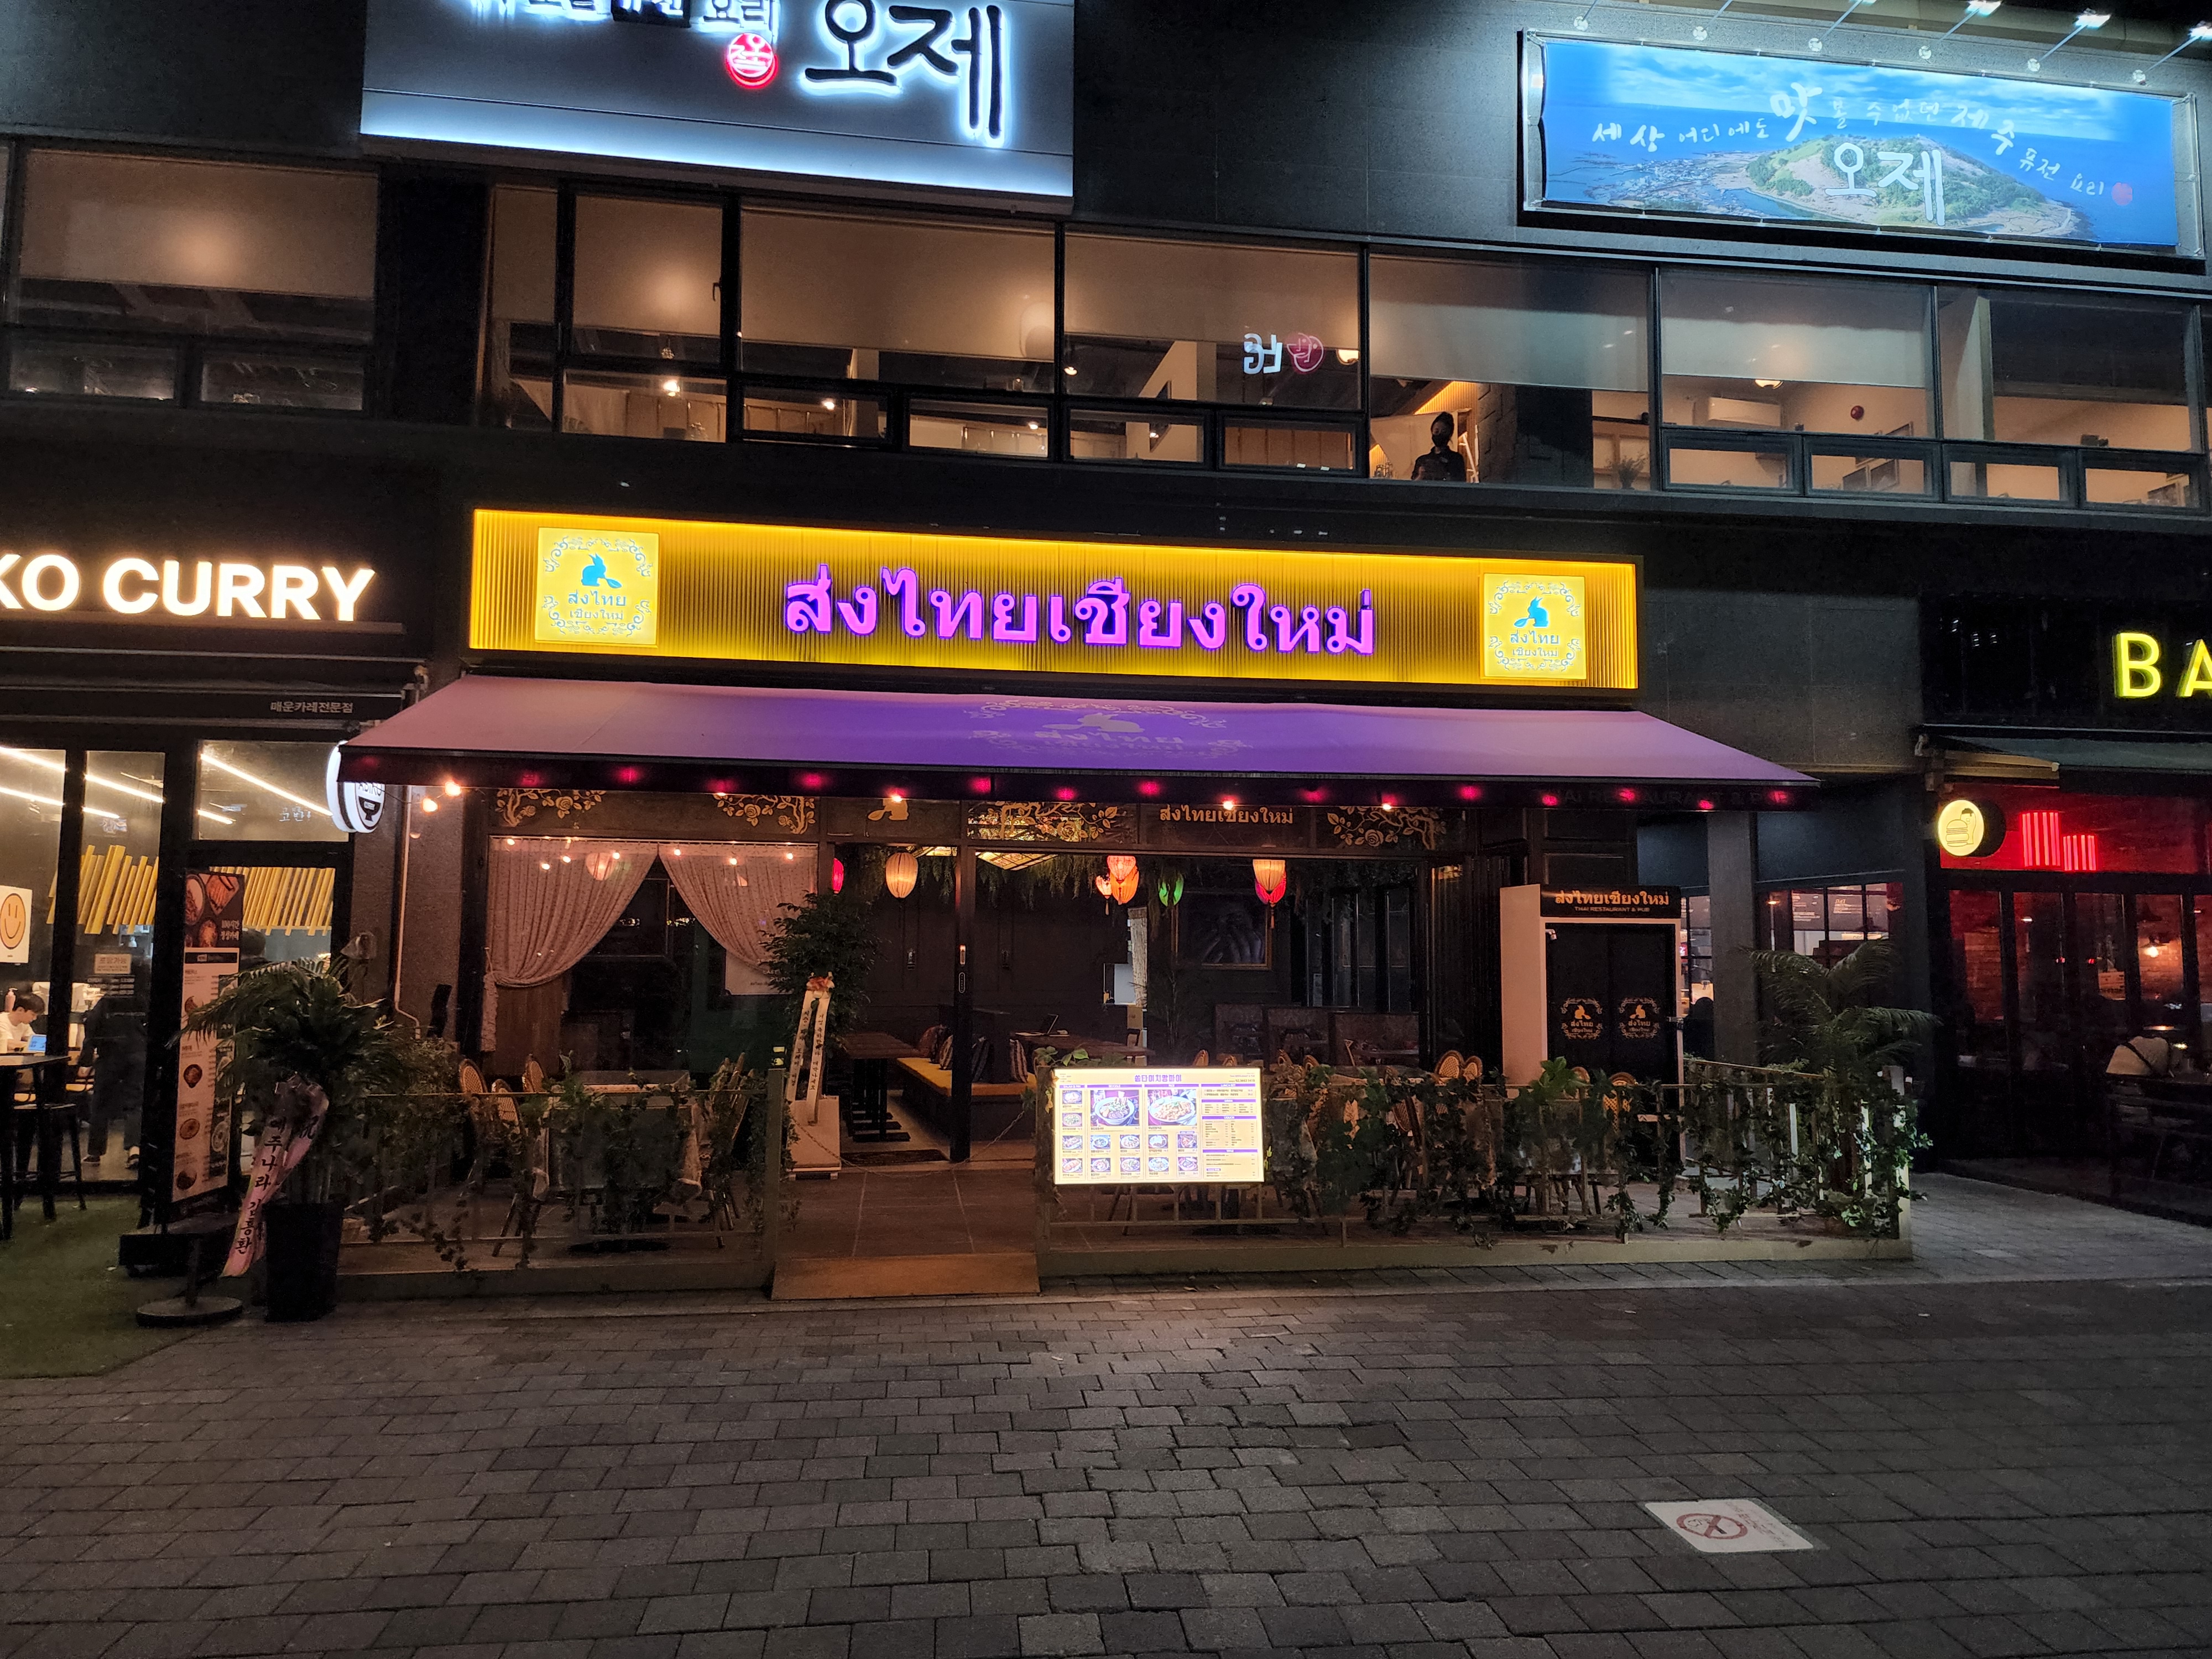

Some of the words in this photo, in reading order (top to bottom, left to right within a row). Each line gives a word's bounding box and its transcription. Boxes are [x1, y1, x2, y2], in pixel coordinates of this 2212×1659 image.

[805, 0, 1002, 139] 오제
[1592, 122, 1665, 152] 세상
[1825, 142, 1945, 226] 오제
[103, 557, 376, 622] CURRY
[568, 590, 627, 607] ส่งไทย
[570, 608, 624, 620] เชียงใหม่
[785, 564, 1374, 655] ส่งไทยเชียงใหม่
[1510, 630, 1559, 644] ส่งไทย
[1512, 647, 1558, 657] เชียงใหม่
[270, 701, 354, 713] 매운카레전문점
